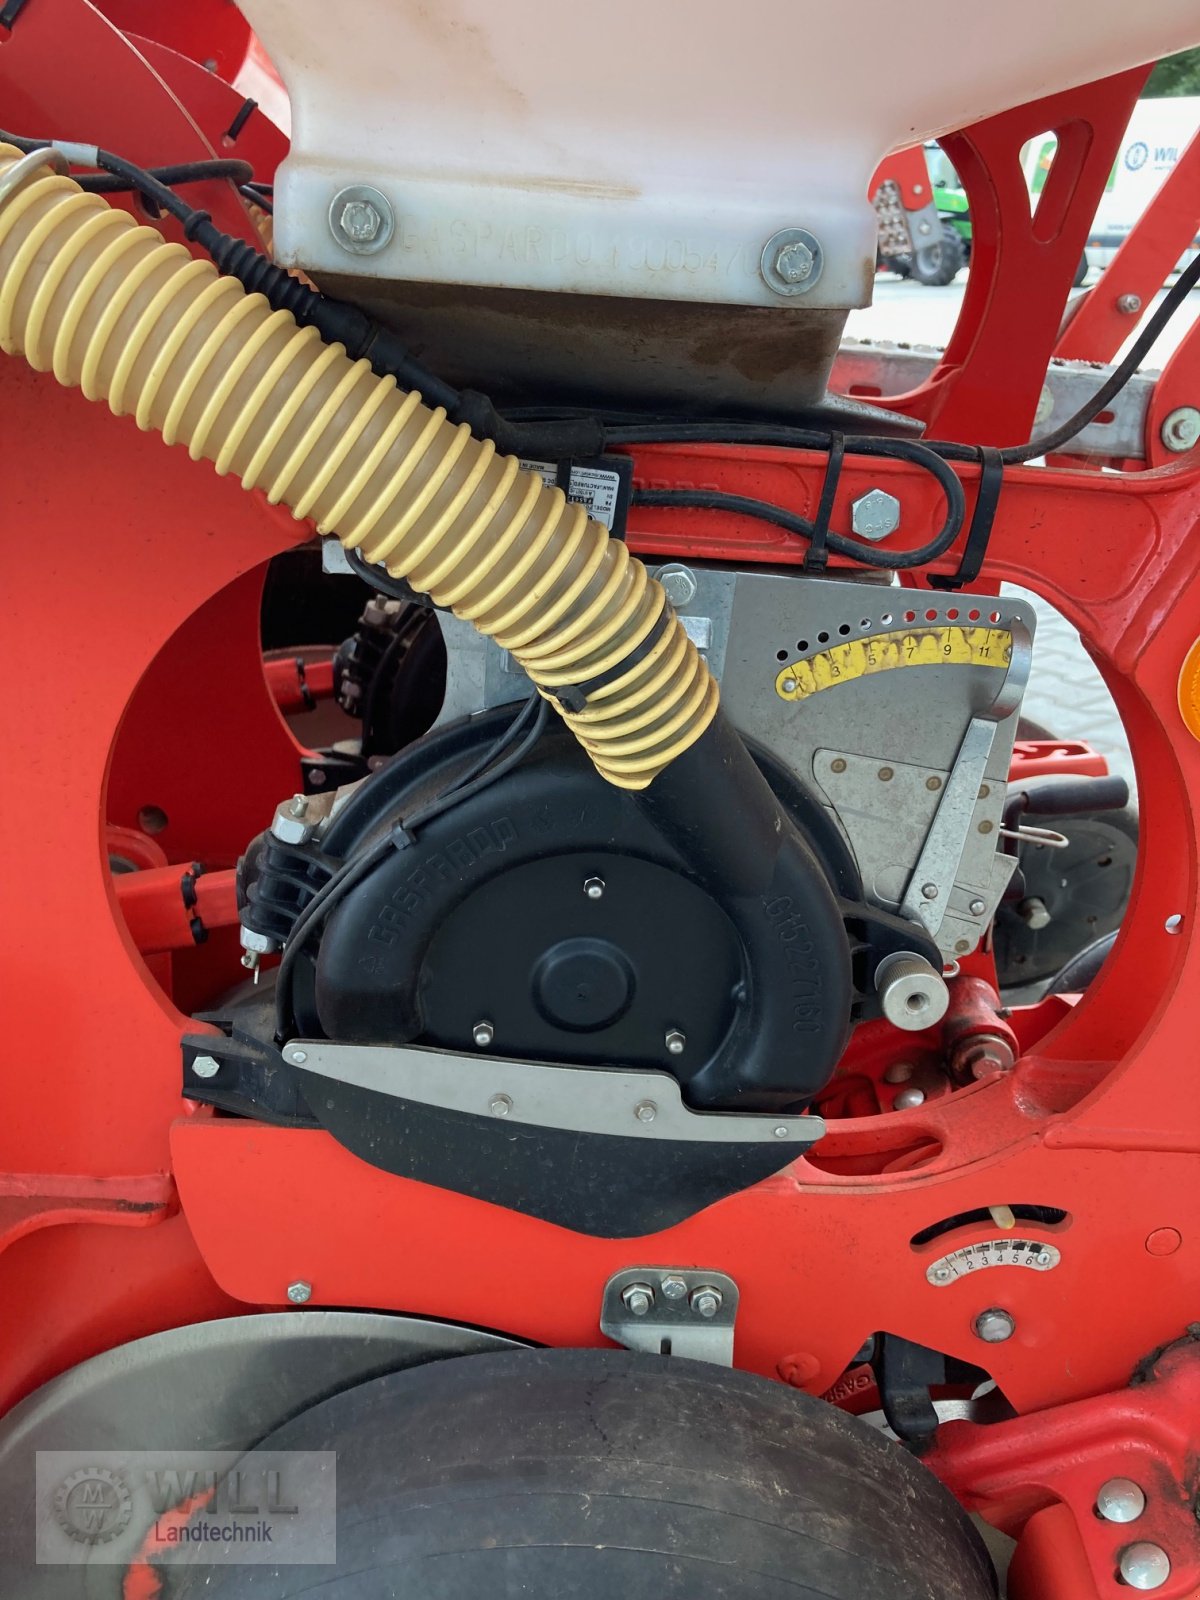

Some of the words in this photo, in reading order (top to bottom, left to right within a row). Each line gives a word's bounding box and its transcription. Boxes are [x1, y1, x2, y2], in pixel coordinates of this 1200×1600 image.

[831, 665, 842, 678] 3
[868, 654, 877, 666] 5
[905, 647, 915, 659] 7
[943, 644, 952, 656] 9
[979, 646, 990, 658] 11
[367, 815, 521, 946] GASPARDO
[966, 1260, 975, 1270] 2
[981, 1256, 989, 1266] 3
[996, 1254, 1004, 1263] 4
[1012, 1254, 1019, 1263] 5
[1025, 1255, 1034, 1266] 6
